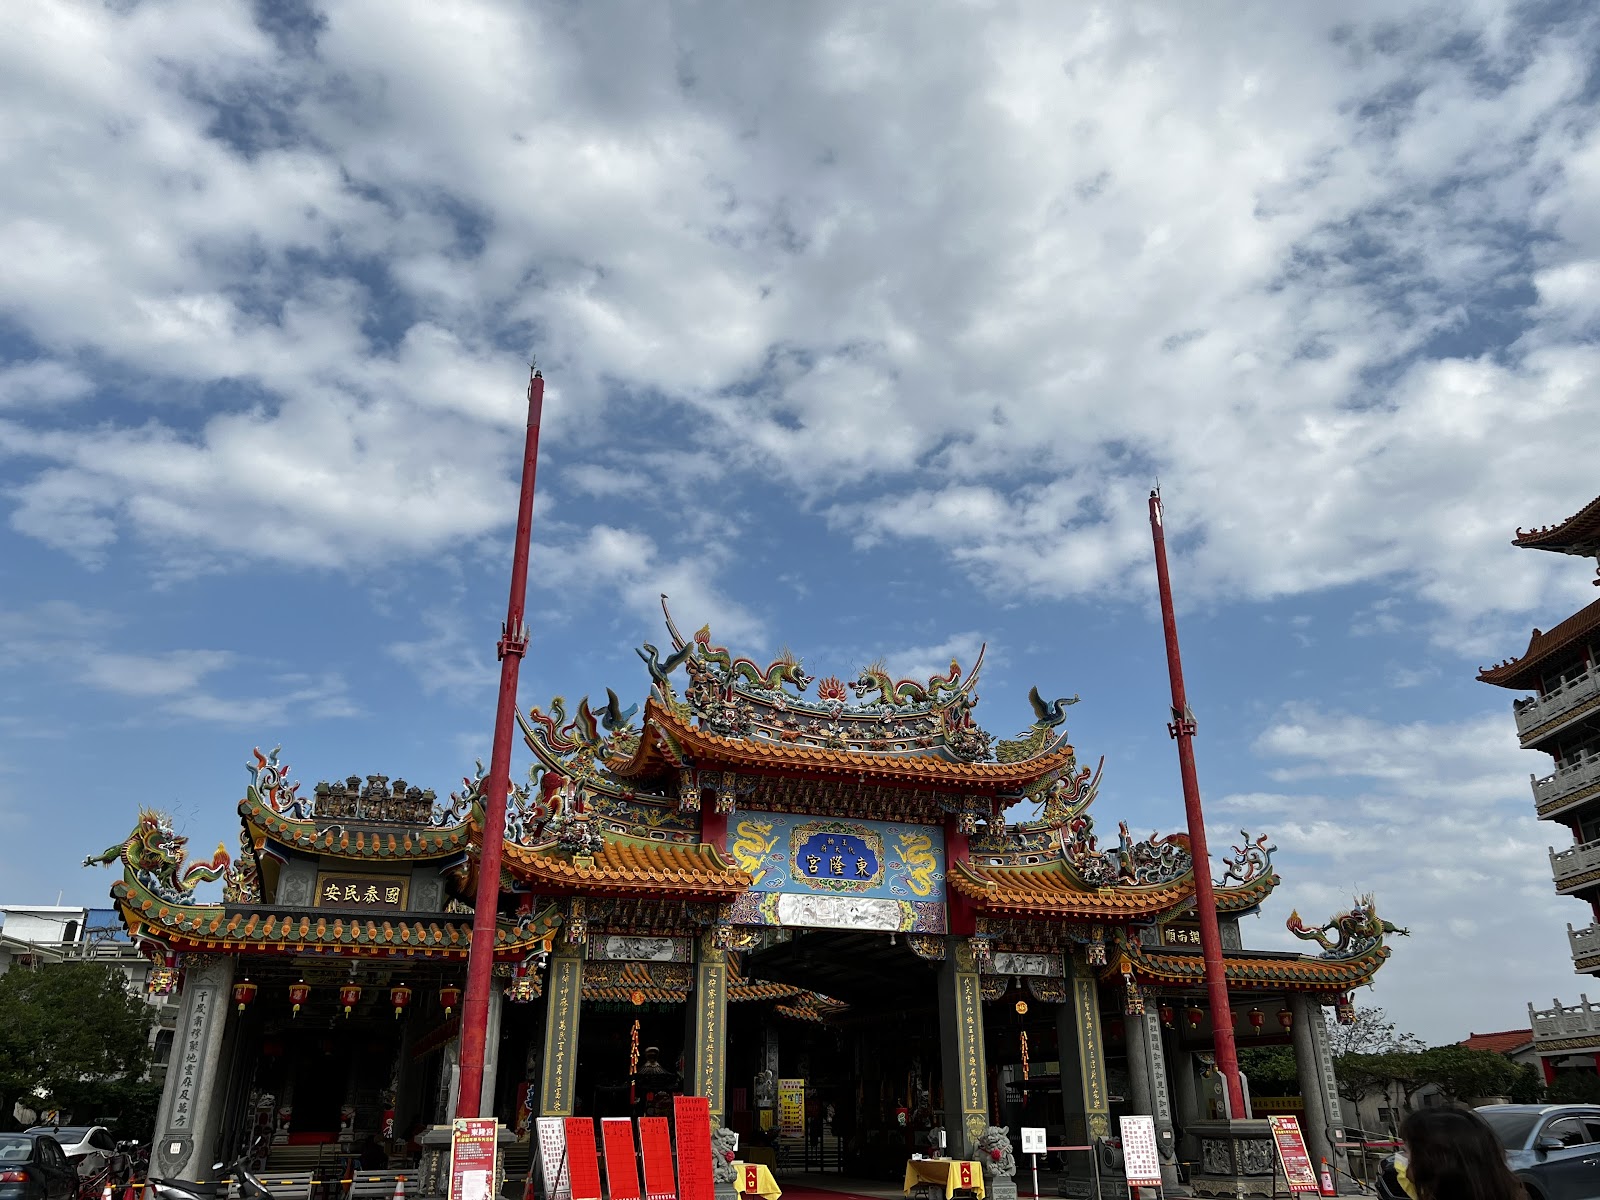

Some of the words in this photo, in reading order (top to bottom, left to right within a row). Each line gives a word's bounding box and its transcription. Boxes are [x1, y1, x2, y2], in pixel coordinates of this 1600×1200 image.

[806, 854, 870, 877] 東隆宮
[323, 884, 400, 905] 國泰民安
[1165, 928, 1200, 945] 調雨順
[747, 1171, 756, 1188] 入口
[962, 1167, 970, 1183] 入口
